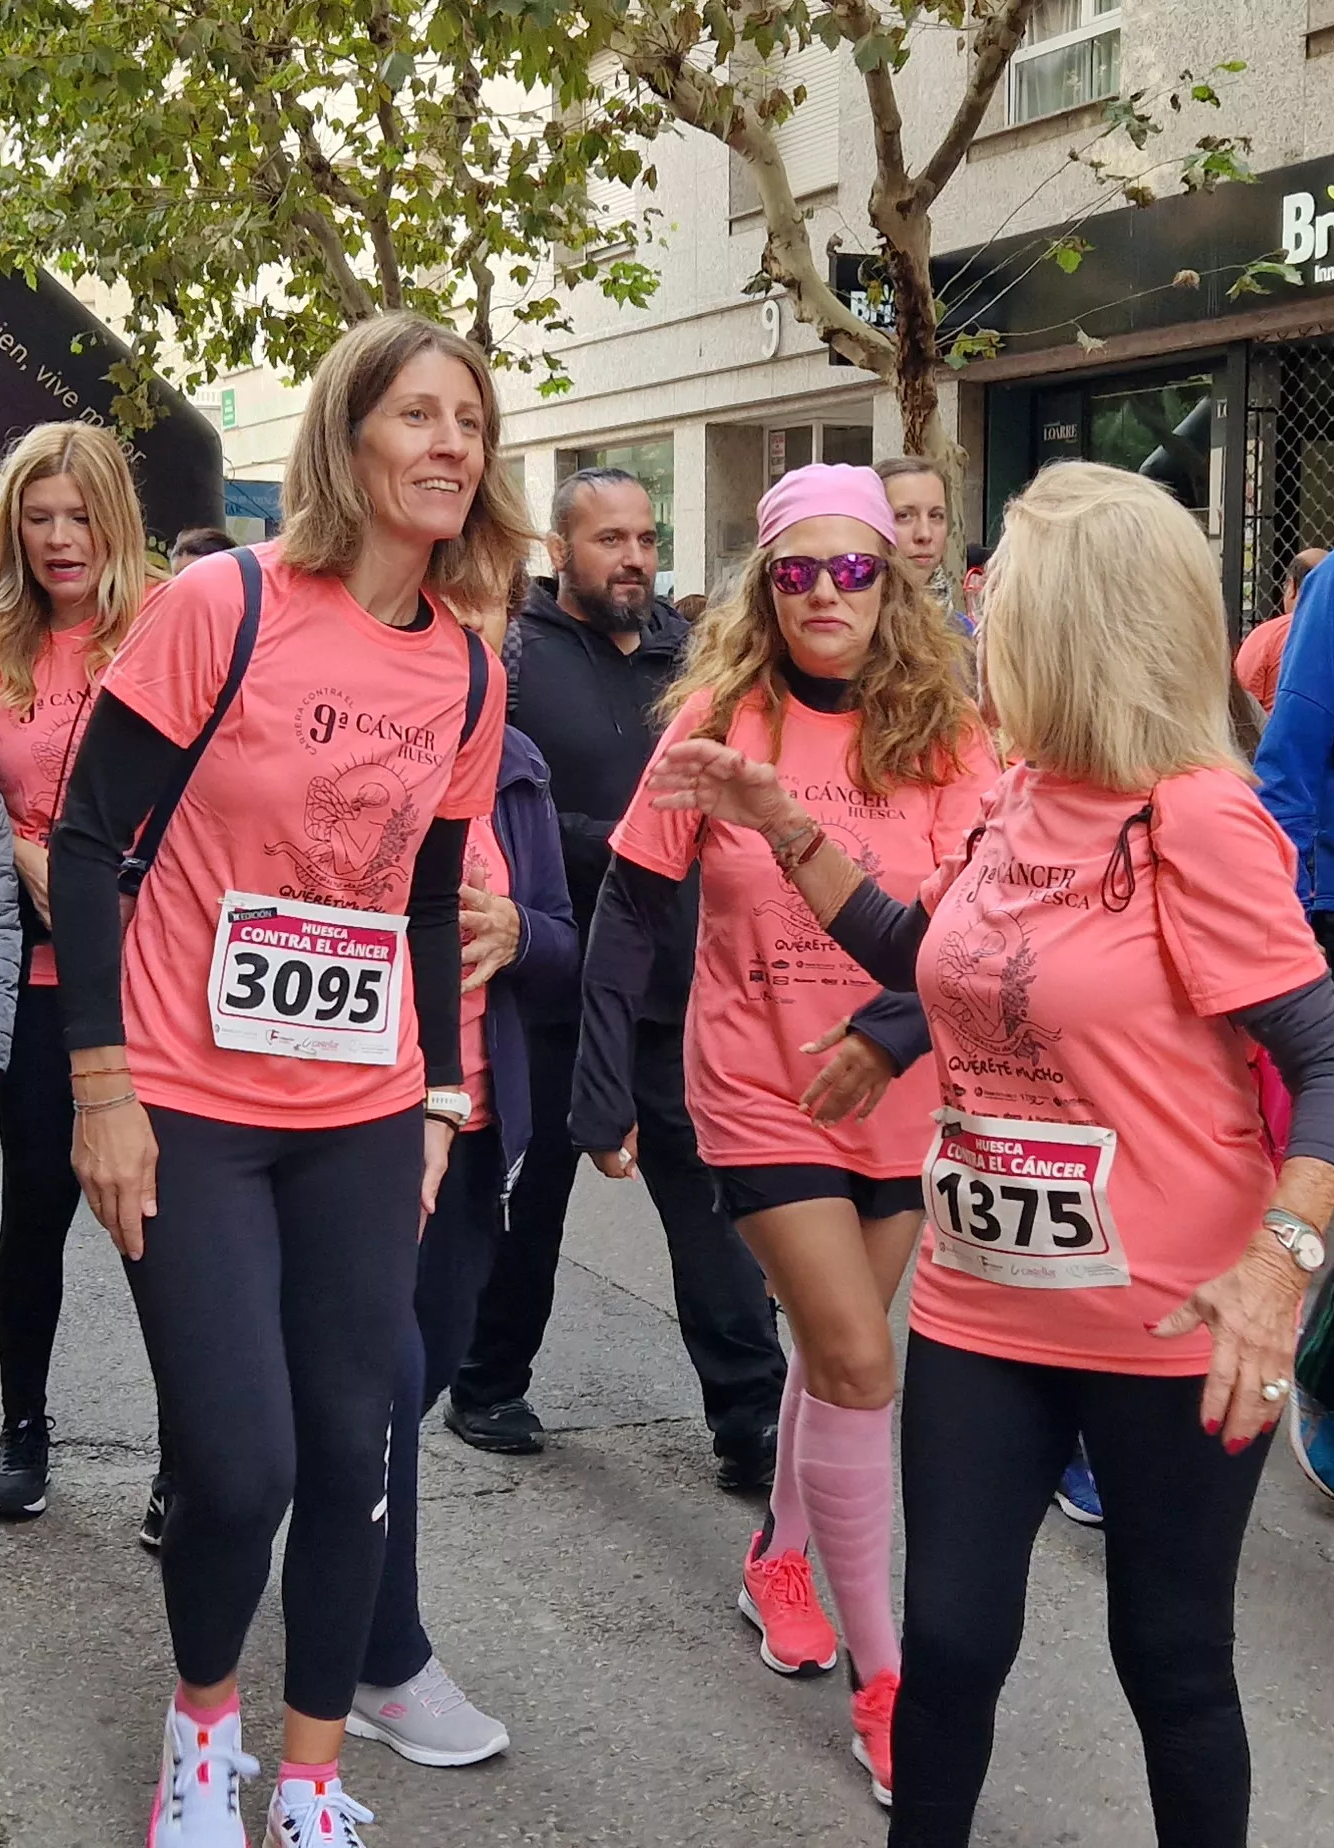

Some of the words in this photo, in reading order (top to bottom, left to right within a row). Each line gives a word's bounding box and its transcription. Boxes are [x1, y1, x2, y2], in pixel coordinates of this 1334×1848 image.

[760, 299, 781, 358] 9
[36, 364, 78, 408] vive
[302, 687, 343, 706] CONTRA
[309, 703, 349, 744] 9ª
[356, 714, 436, 752] CÁNCER
[848, 806, 907, 820] HUESCA
[240, 926, 312, 951] CONTRA
[316, 940, 333, 954] EL
[336, 937, 390, 960] CÁNCER
[301, 922, 349, 940] HUESCA
[225, 951, 383, 1024] 3095
[1015, 1067, 1064, 1084] MUCHO
[975, 1138, 1024, 1156] HUESCA
[988, 1155, 1007, 1173] EL
[1010, 1155, 1088, 1178] CÁNCER
[936, 1172, 1094, 1248] 1375
